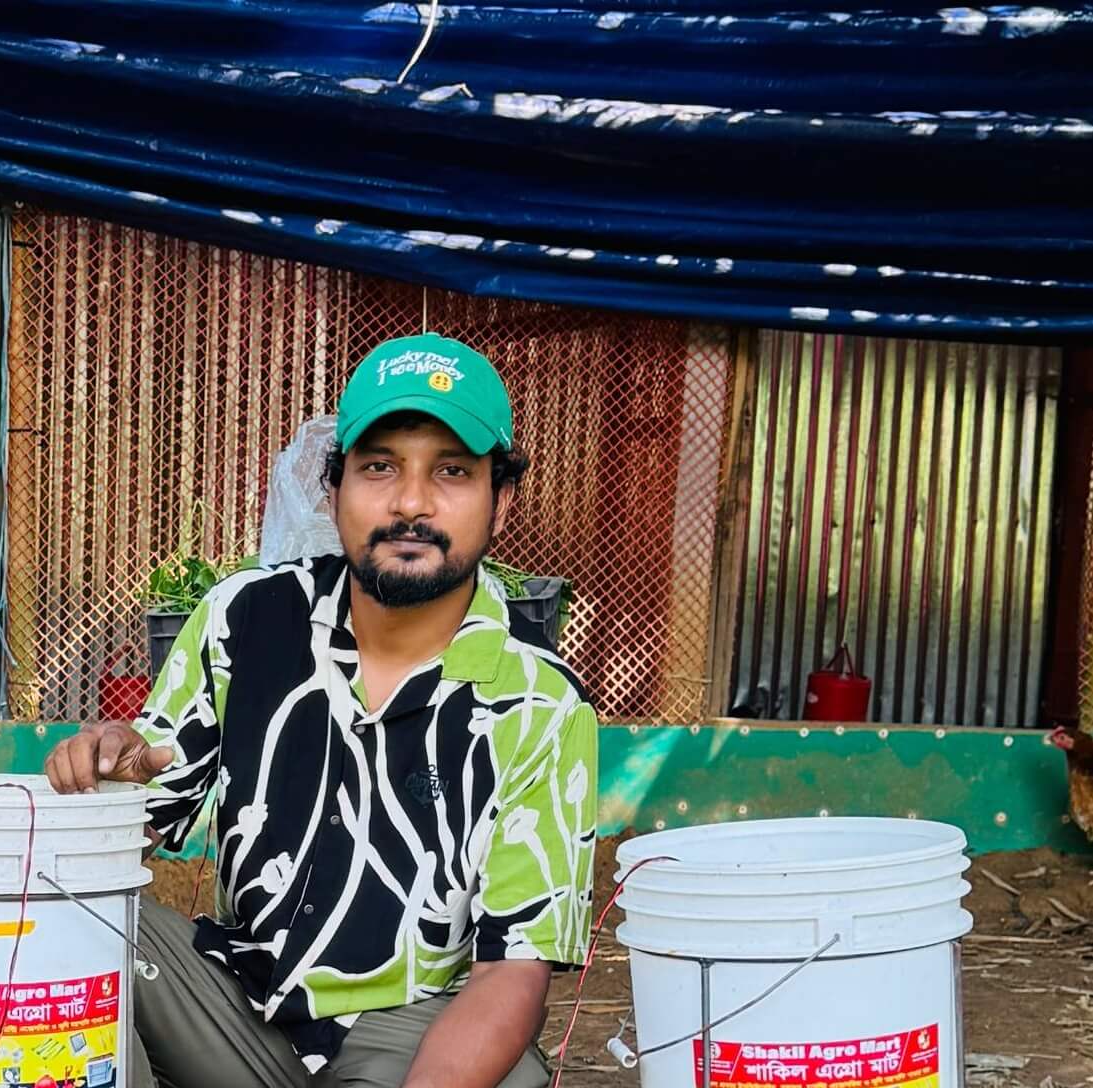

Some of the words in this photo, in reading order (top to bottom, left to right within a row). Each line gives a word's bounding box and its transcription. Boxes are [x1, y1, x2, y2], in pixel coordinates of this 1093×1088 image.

[377, 350, 425, 373] Lucky
[377, 371, 387, 386] I
[415, 360, 465, 381] Money
[1, 986, 47, 1003] Agro
[49, 982, 87, 998] Mart
[6, 1002, 53, 1022] এগ্রো
[55, 995, 87, 1019] মার্ট
[742, 1045, 806, 1059] Shakil
[808, 1045, 858, 1060] Agro
[860, 1036, 901, 1054] Mart
[744, 1060, 809, 1081] শাকিল
[815, 1059, 865, 1080] এগ্রো
[868, 1049, 901, 1074] মার্ট
